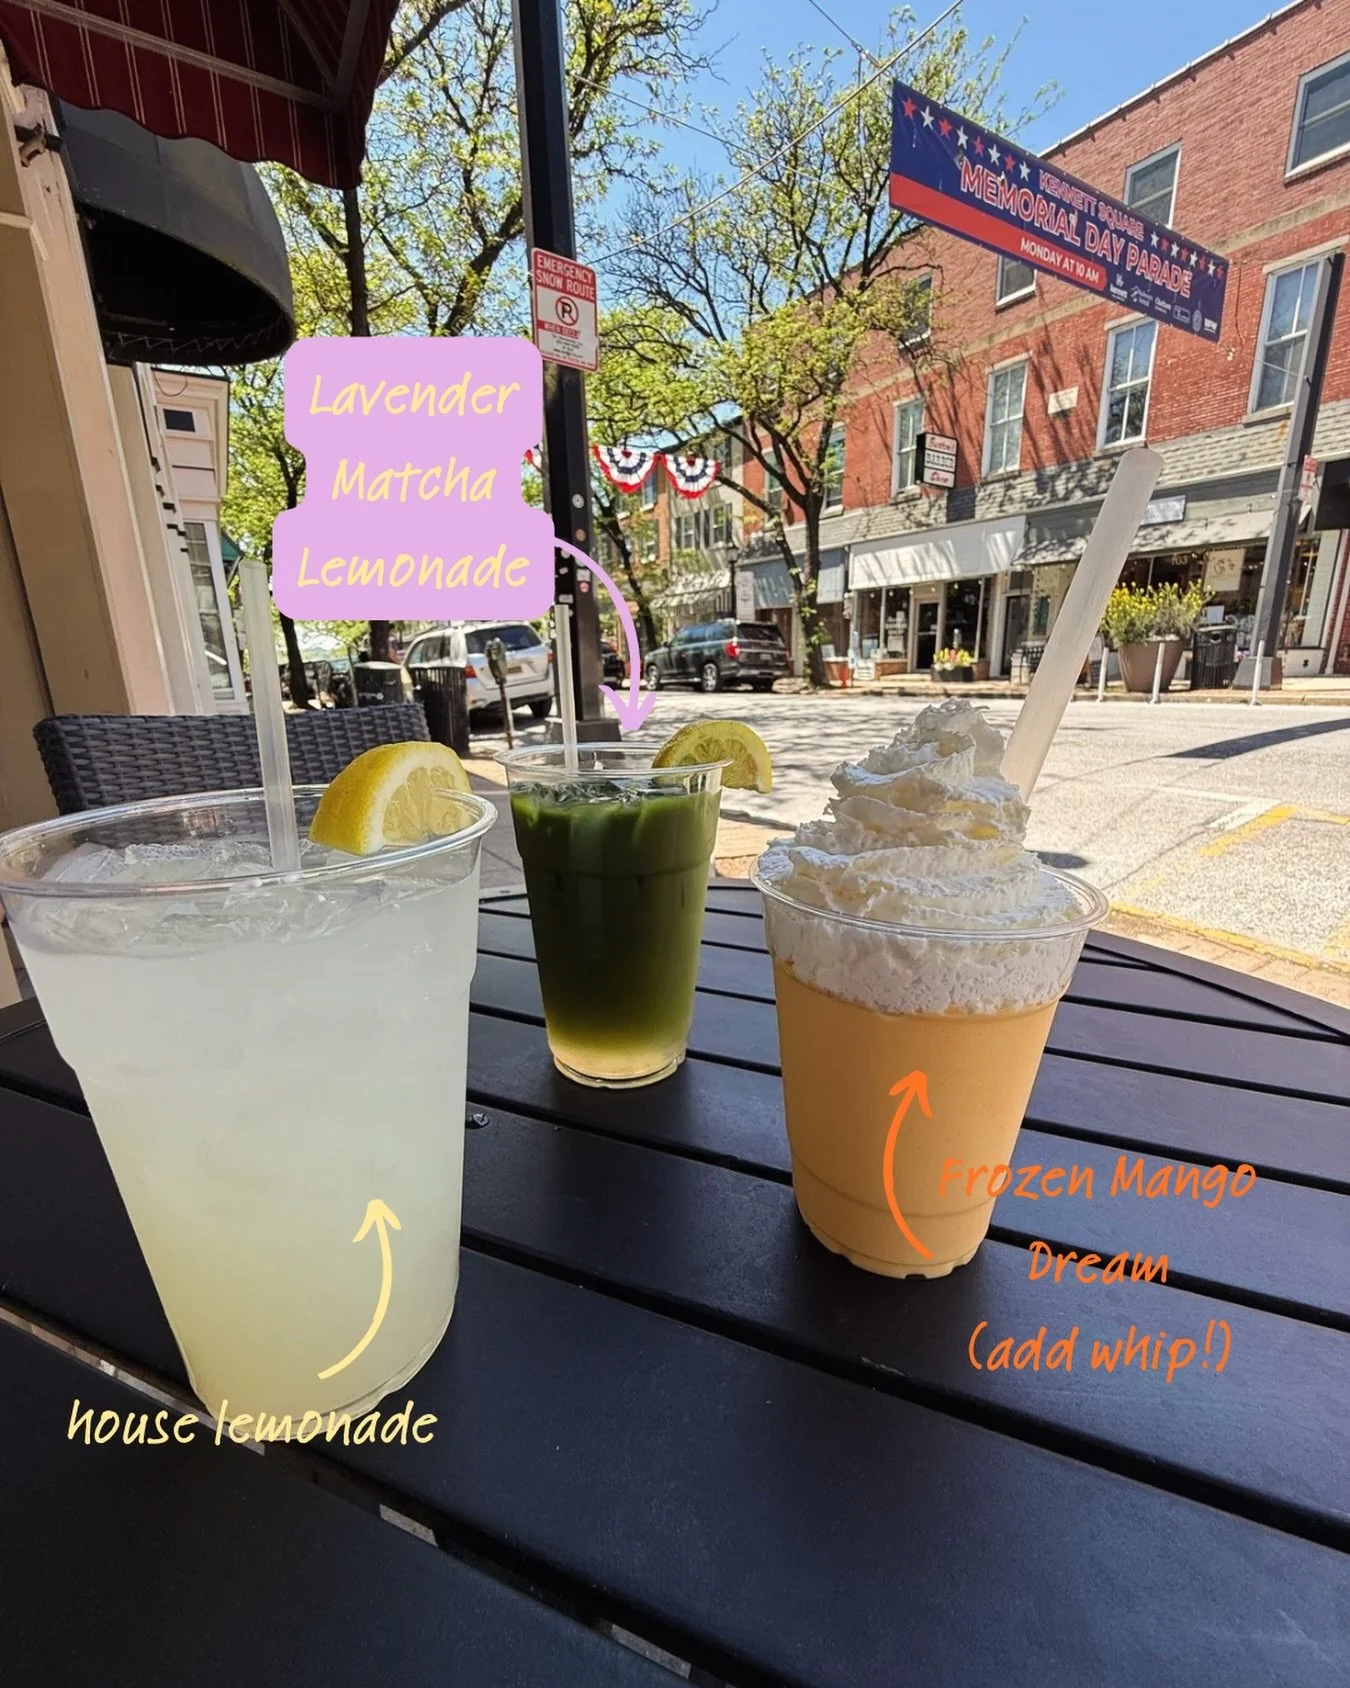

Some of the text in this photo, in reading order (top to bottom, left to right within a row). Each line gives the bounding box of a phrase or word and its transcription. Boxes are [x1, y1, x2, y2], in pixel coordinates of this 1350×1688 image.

[960, 155, 1192, 298] MEMORIAL DAY PARADE
[1039, 169, 1145, 242] KENNETT SQUARE
[536, 255, 593, 284] EMERGENCY
[1020, 237, 1099, 284] MONDAY AT 10 AM
[536, 269, 595, 300] SNOW ROUTE
